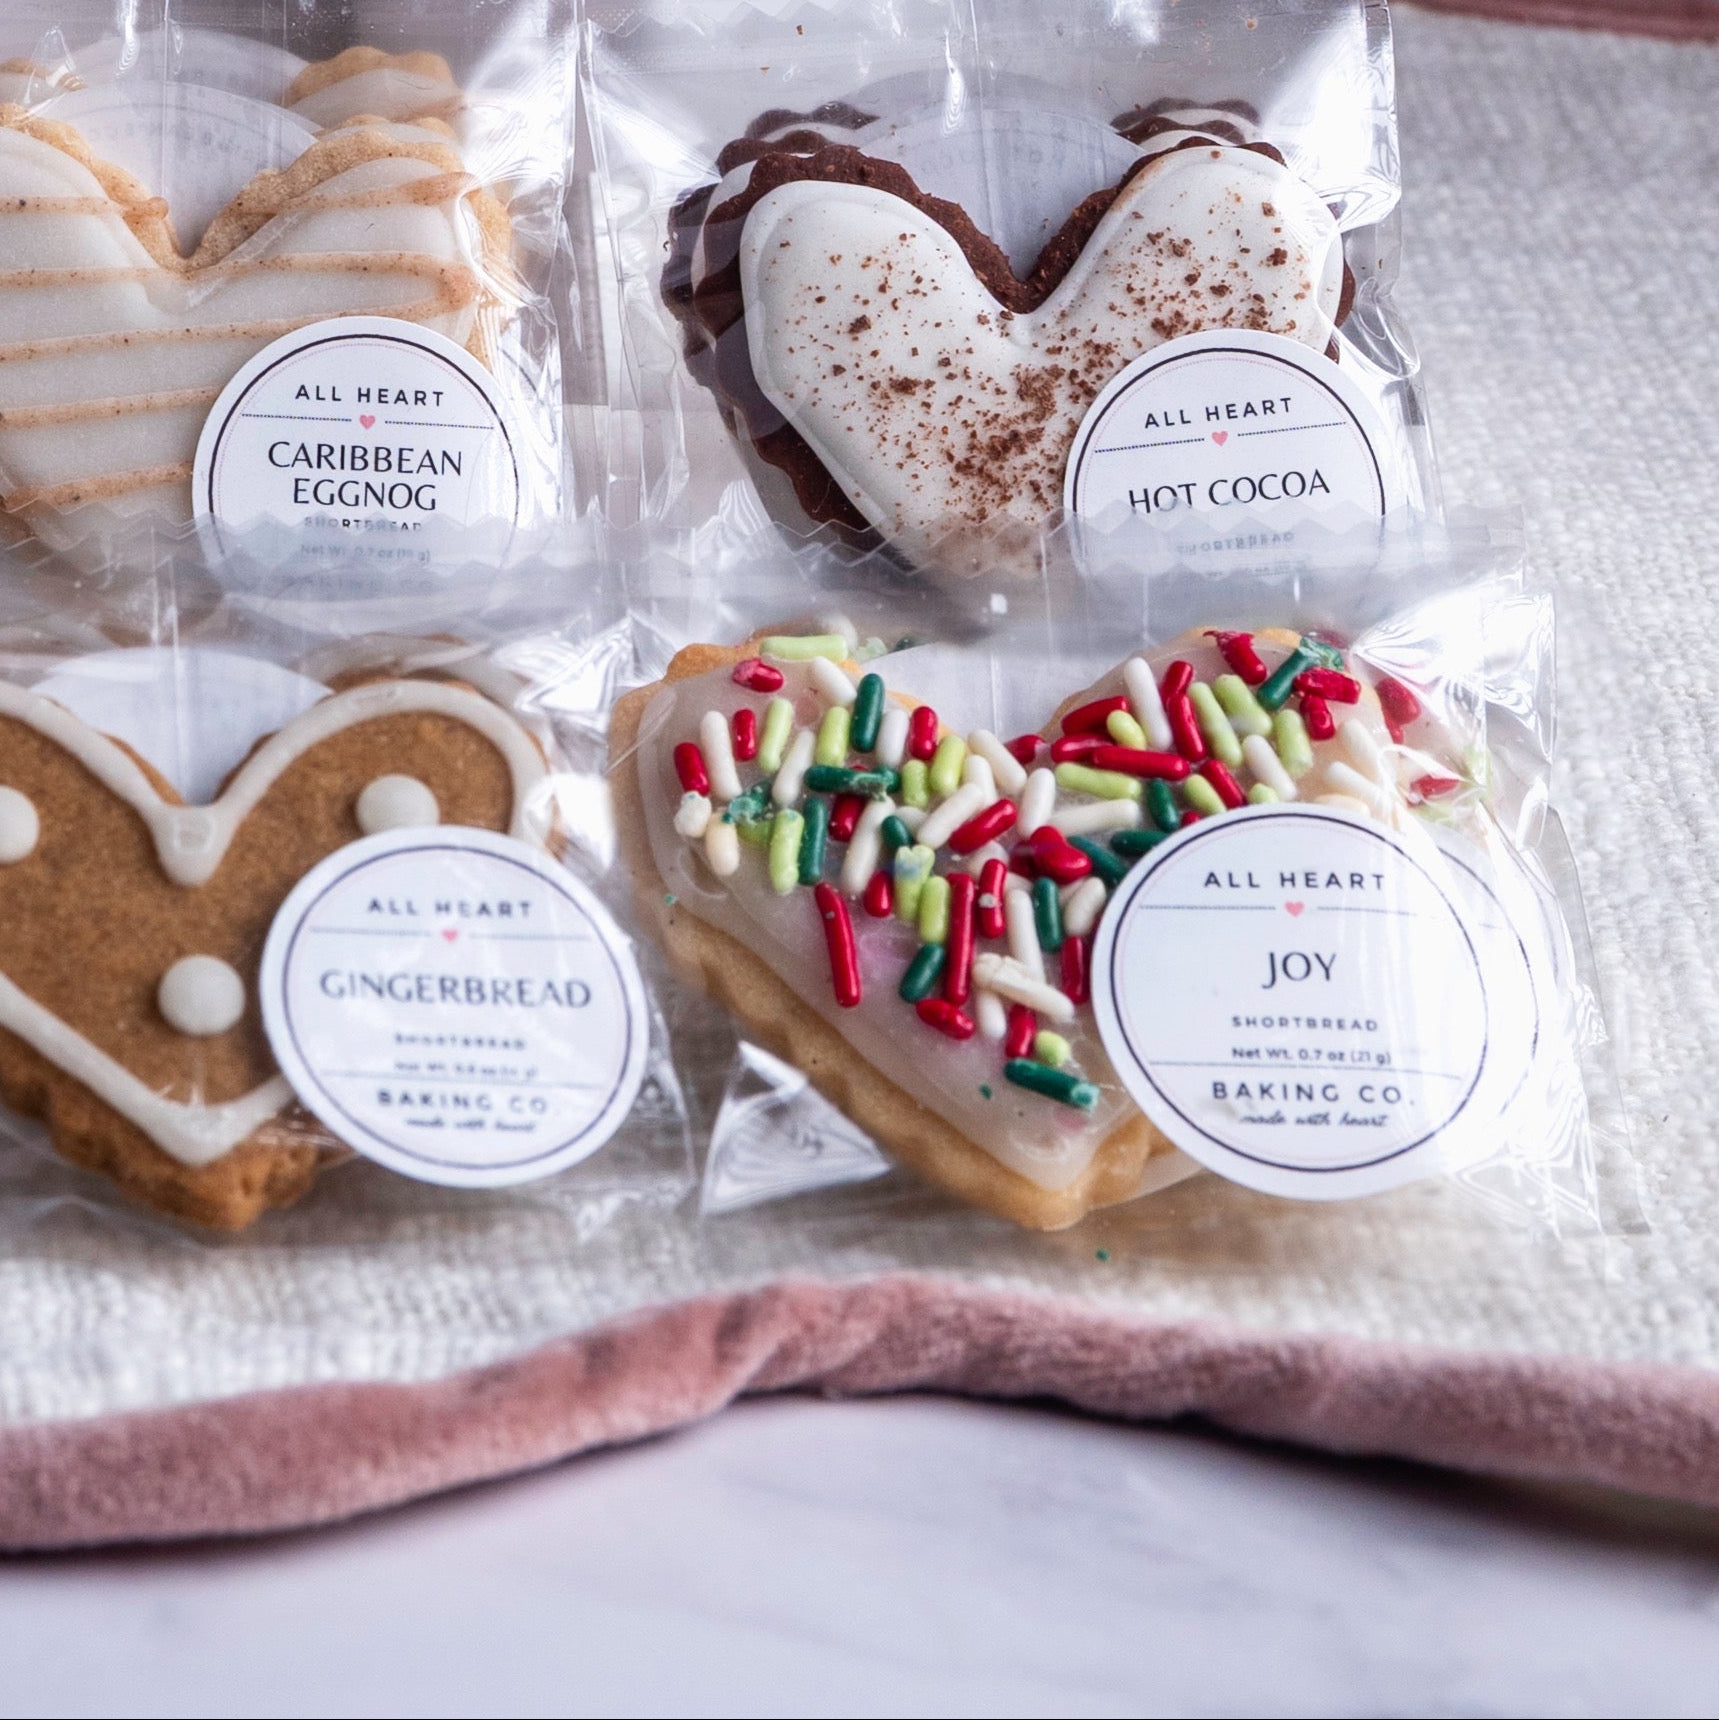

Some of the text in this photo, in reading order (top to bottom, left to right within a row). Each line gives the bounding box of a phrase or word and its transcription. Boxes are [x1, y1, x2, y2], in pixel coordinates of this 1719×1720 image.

[294, 384, 444, 407] ALL HEART
[1144, 397, 1292, 429] ALL HEART
[268, 441, 462, 476] CARIBBEAN
[293, 477, 436, 511] EGGNOG
[1129, 469, 1331, 514] HOT COCOA
[1204, 871, 1386, 891] ALL HEART
[368, 898, 531, 918] ALL HEART
[1262, 951, 1336, 989] JOY
[319, 970, 592, 1008] GINGERBREAD
[1232, 1015, 1378, 1032] SHORTBREAD
[1232, 1047, 1261, 1060] Net
[1298, 1048, 1321, 1062] 0.7
[1324, 1052, 1345, 1063] oz
[1375, 1052, 1392, 1065] g)
[377, 1089, 493, 1110] BAKING
[1212, 1081, 1416, 1106] BAKING CO.
